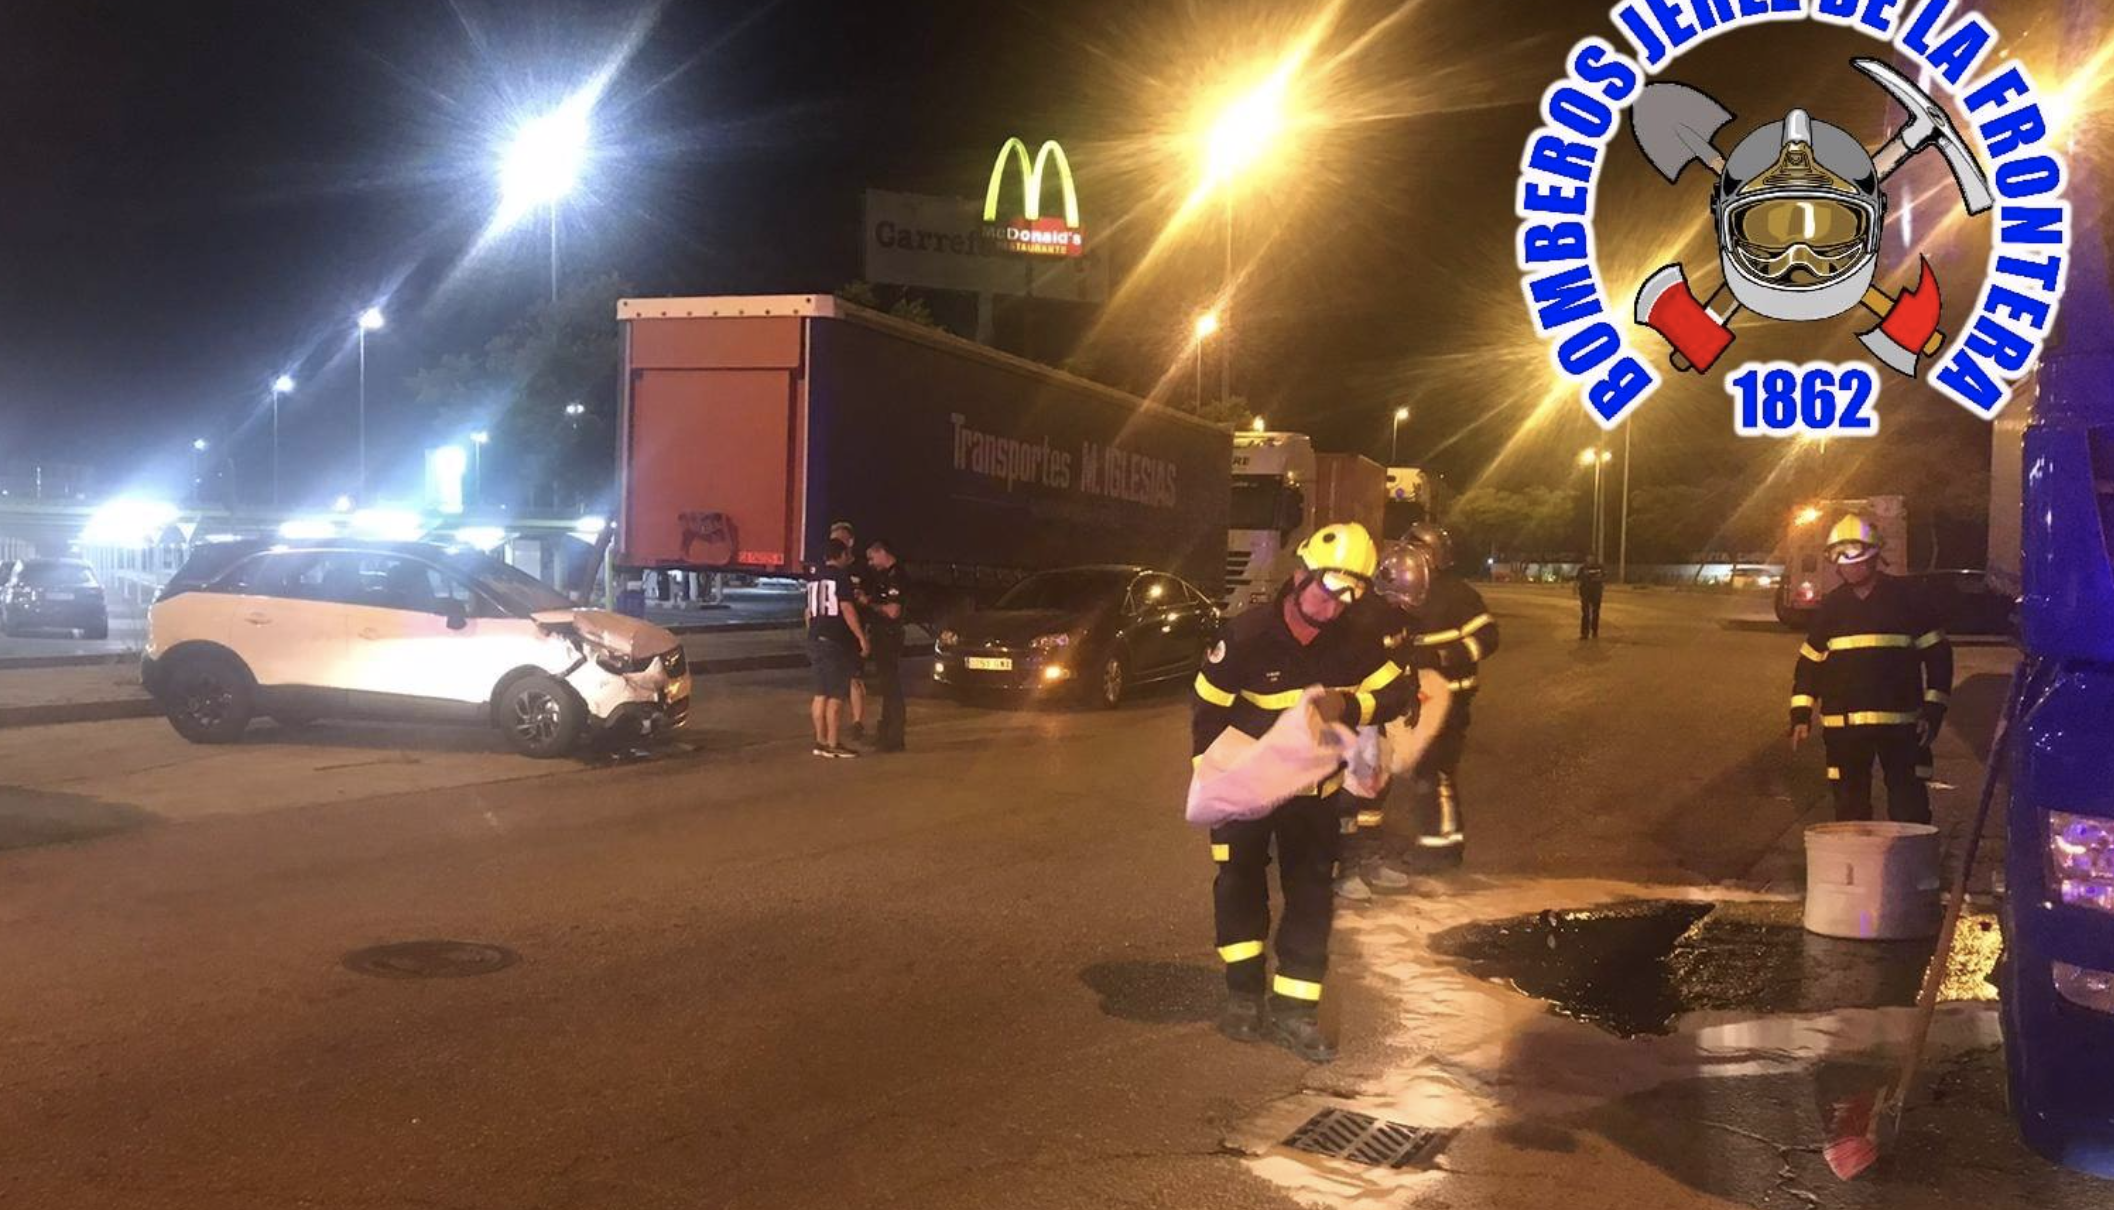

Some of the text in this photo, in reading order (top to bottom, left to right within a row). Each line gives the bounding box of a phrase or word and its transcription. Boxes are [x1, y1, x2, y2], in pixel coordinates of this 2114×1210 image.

[875, 220, 984, 255] Carref
[951, 412, 1071, 492] Transportes
[1103, 445, 1177, 507] IGLESIAS
